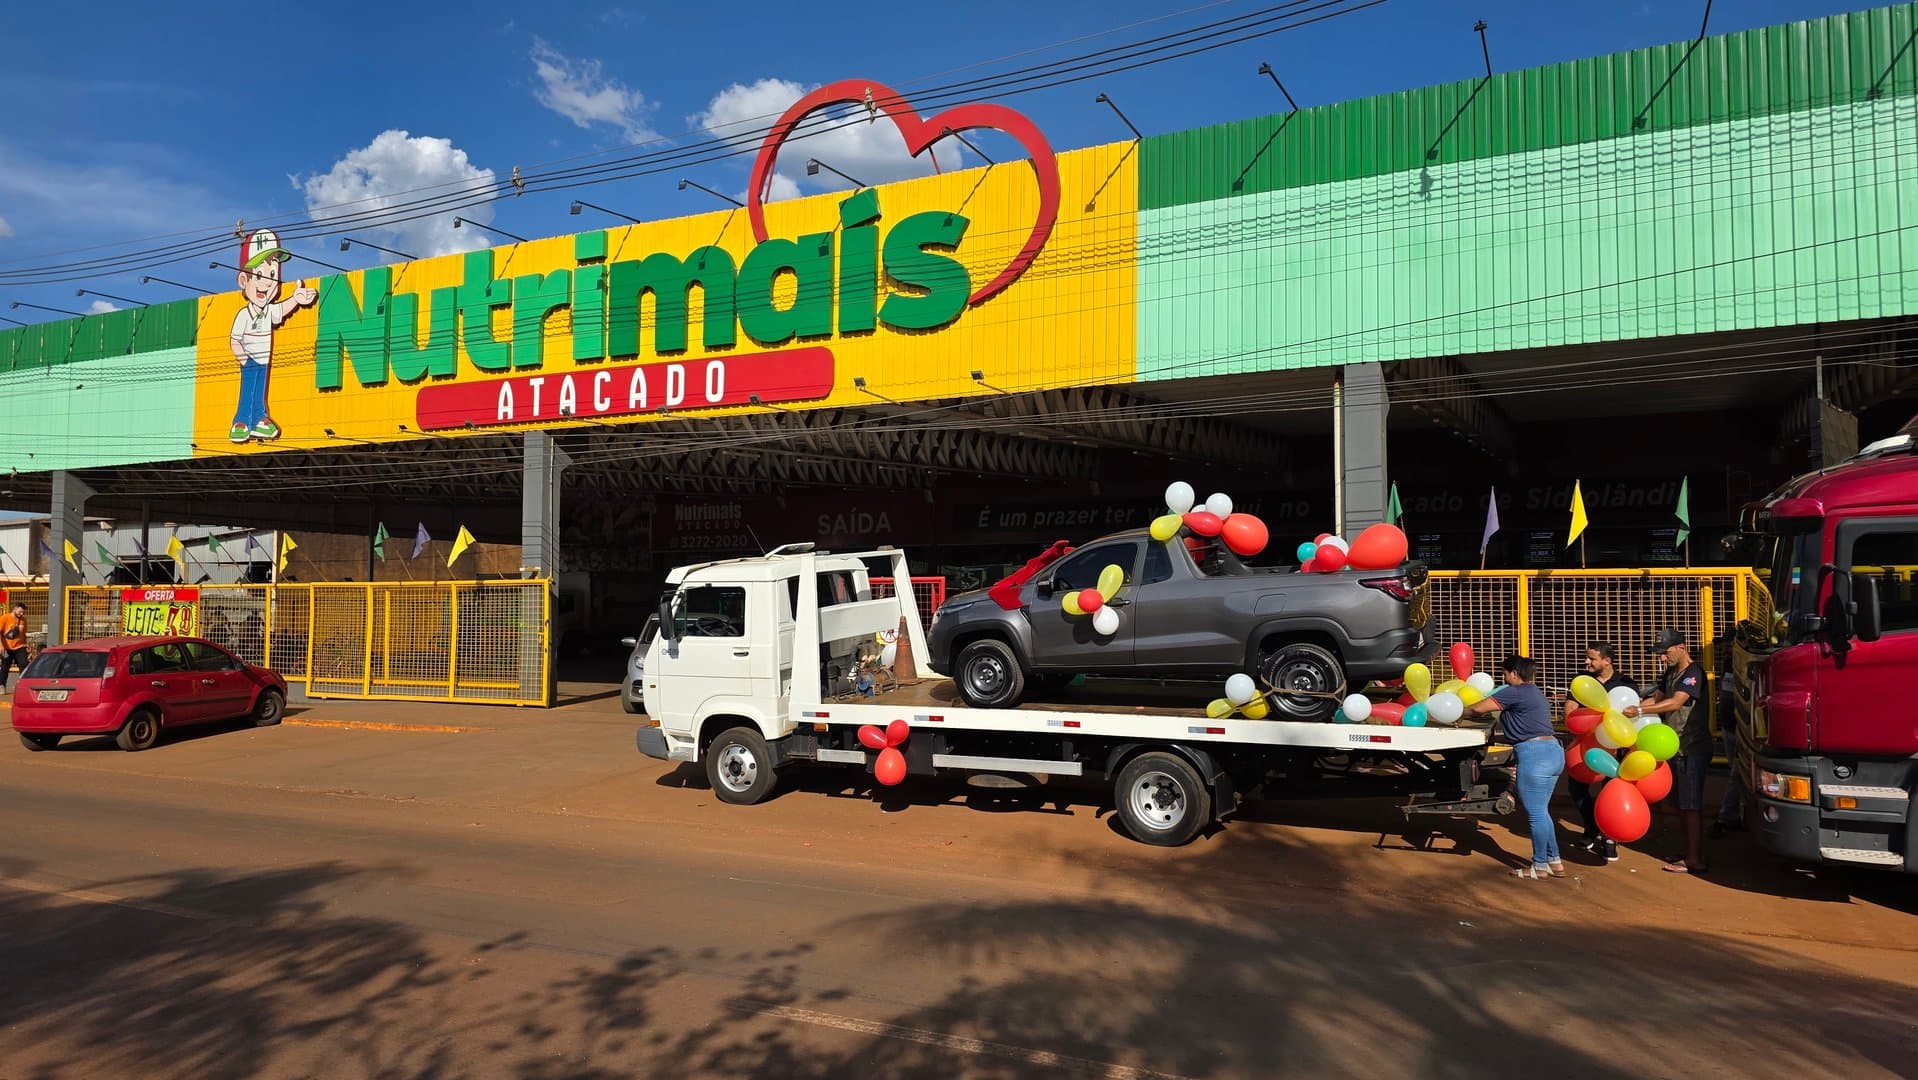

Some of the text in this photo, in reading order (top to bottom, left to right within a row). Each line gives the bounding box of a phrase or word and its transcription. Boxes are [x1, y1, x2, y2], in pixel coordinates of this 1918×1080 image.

[316, 187, 971, 390] Nutrimais
[497, 359, 725, 421] ATACADO
[675, 501, 742, 521] Nutrimais
[818, 507, 893, 535] SAÍDA
[999, 511, 1027, 528] um
[1033, 508, 1099, 531] prazer
[1105, 505, 1135, 525] ter
[680, 534, 749, 549] 3272-2020
[144, 590, 175, 601] OFERTA
[126, 607, 161, 635] LEITE
